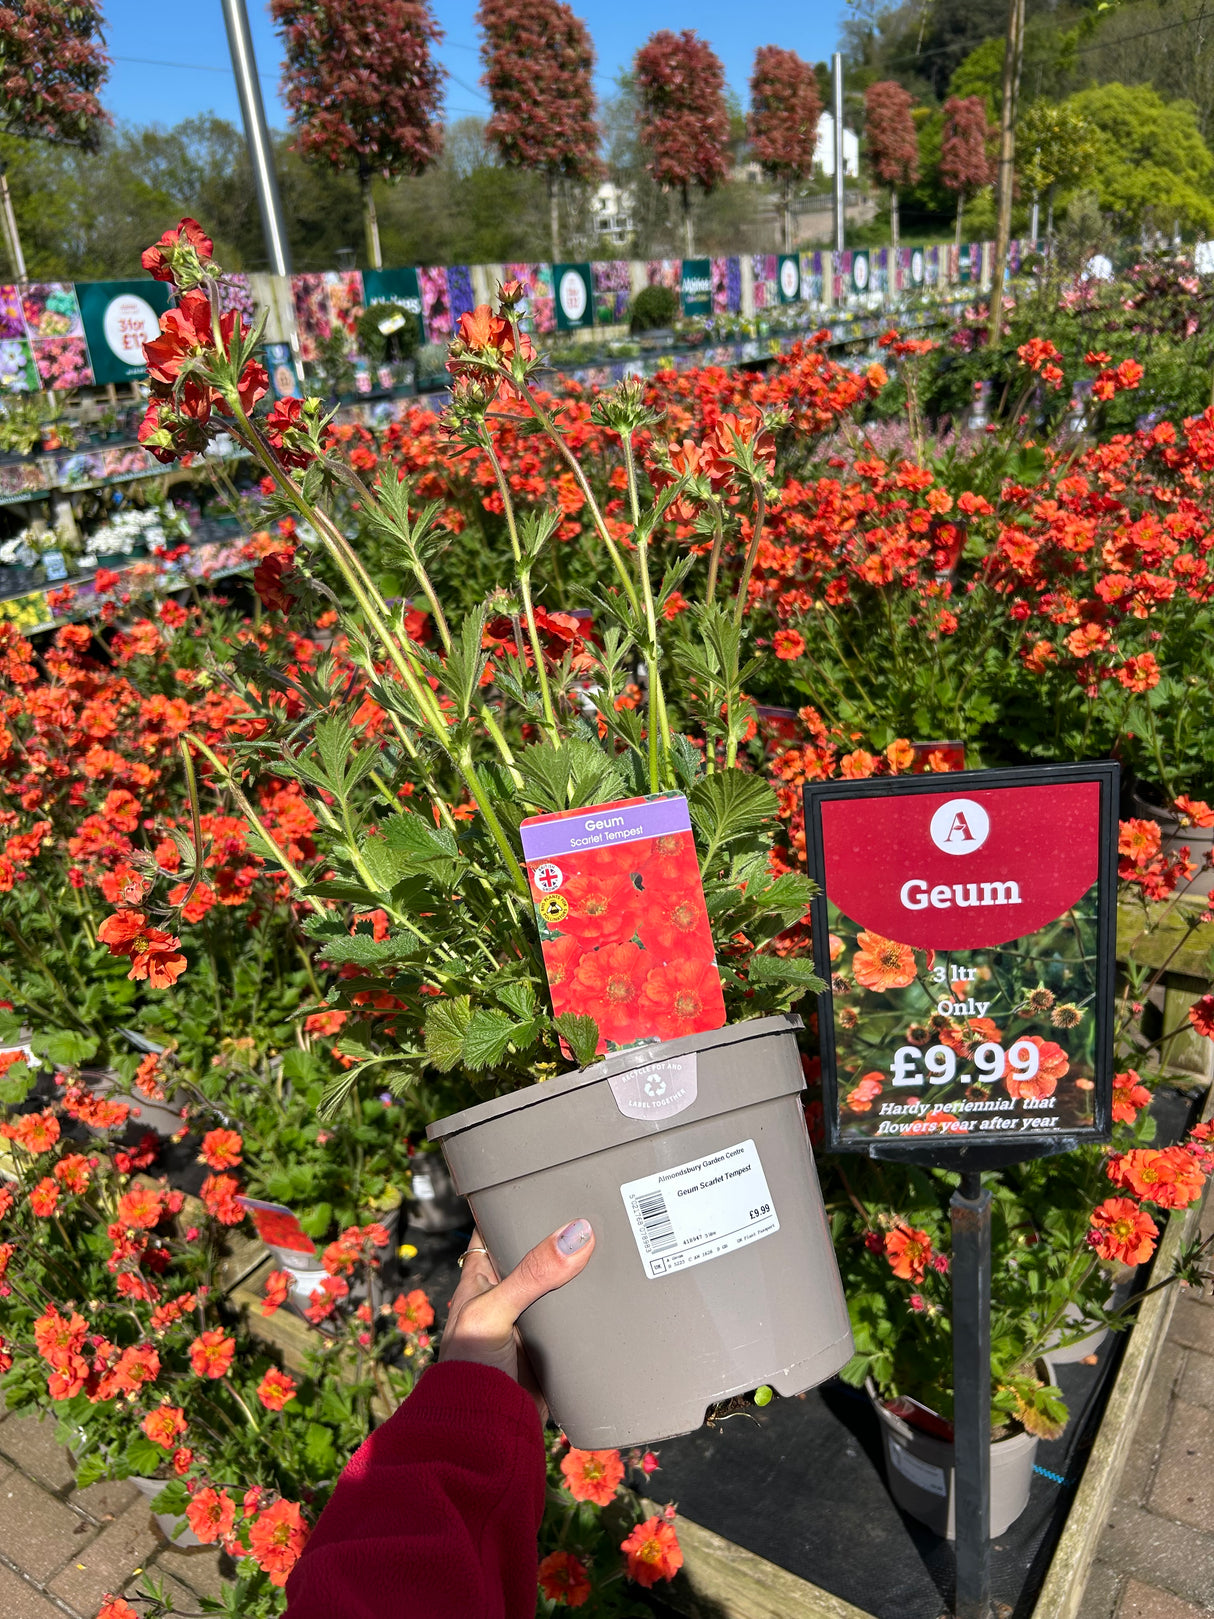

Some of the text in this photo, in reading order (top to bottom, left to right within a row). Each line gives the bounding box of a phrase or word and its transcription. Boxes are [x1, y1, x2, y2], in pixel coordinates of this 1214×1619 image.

[585, 816, 624, 831] Geum
[943, 810, 977, 842] A
[570, 826, 643, 848] Scarlet Tempest
[900, 879, 1023, 911] Geum
[933, 963, 978, 983] 3 ltr
[937, 998, 991, 1018] Only
[622, 1063, 682, 1083] RECYCLE POT AND
[890, 1040, 1040, 1087] £9.99
[628, 1088, 687, 1108] LABEL TOGETHER
[879, 1097, 1057, 1117] Hardy periennial that
[877, 1115, 1060, 1134] flowers year after year
[658, 1147, 745, 1184] Almondsbury Garden Centre
[677, 1164, 752, 1198] Geum Scarlet Tempest
[749, 1204, 771, 1220] £9.99
